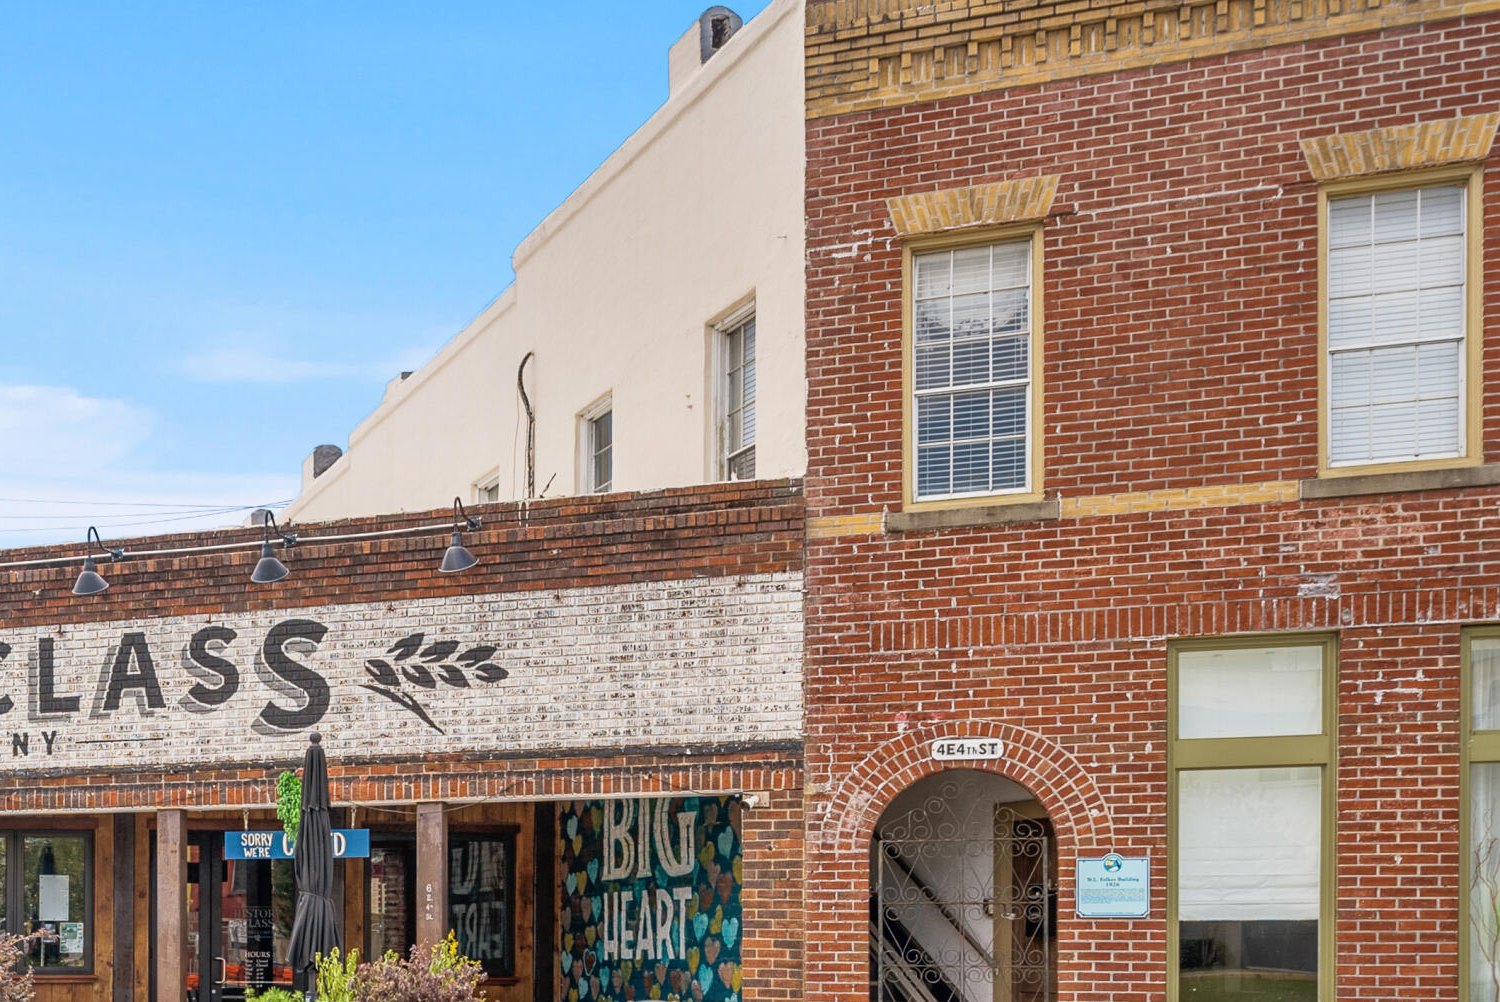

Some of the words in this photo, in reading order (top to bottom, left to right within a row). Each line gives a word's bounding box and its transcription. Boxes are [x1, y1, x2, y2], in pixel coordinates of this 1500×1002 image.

[240, 832, 273, 847] SORRY
[243, 846, 271, 858] WE'RE
[601, 797, 697, 881] BIG
[602, 886, 692, 961] HEART
